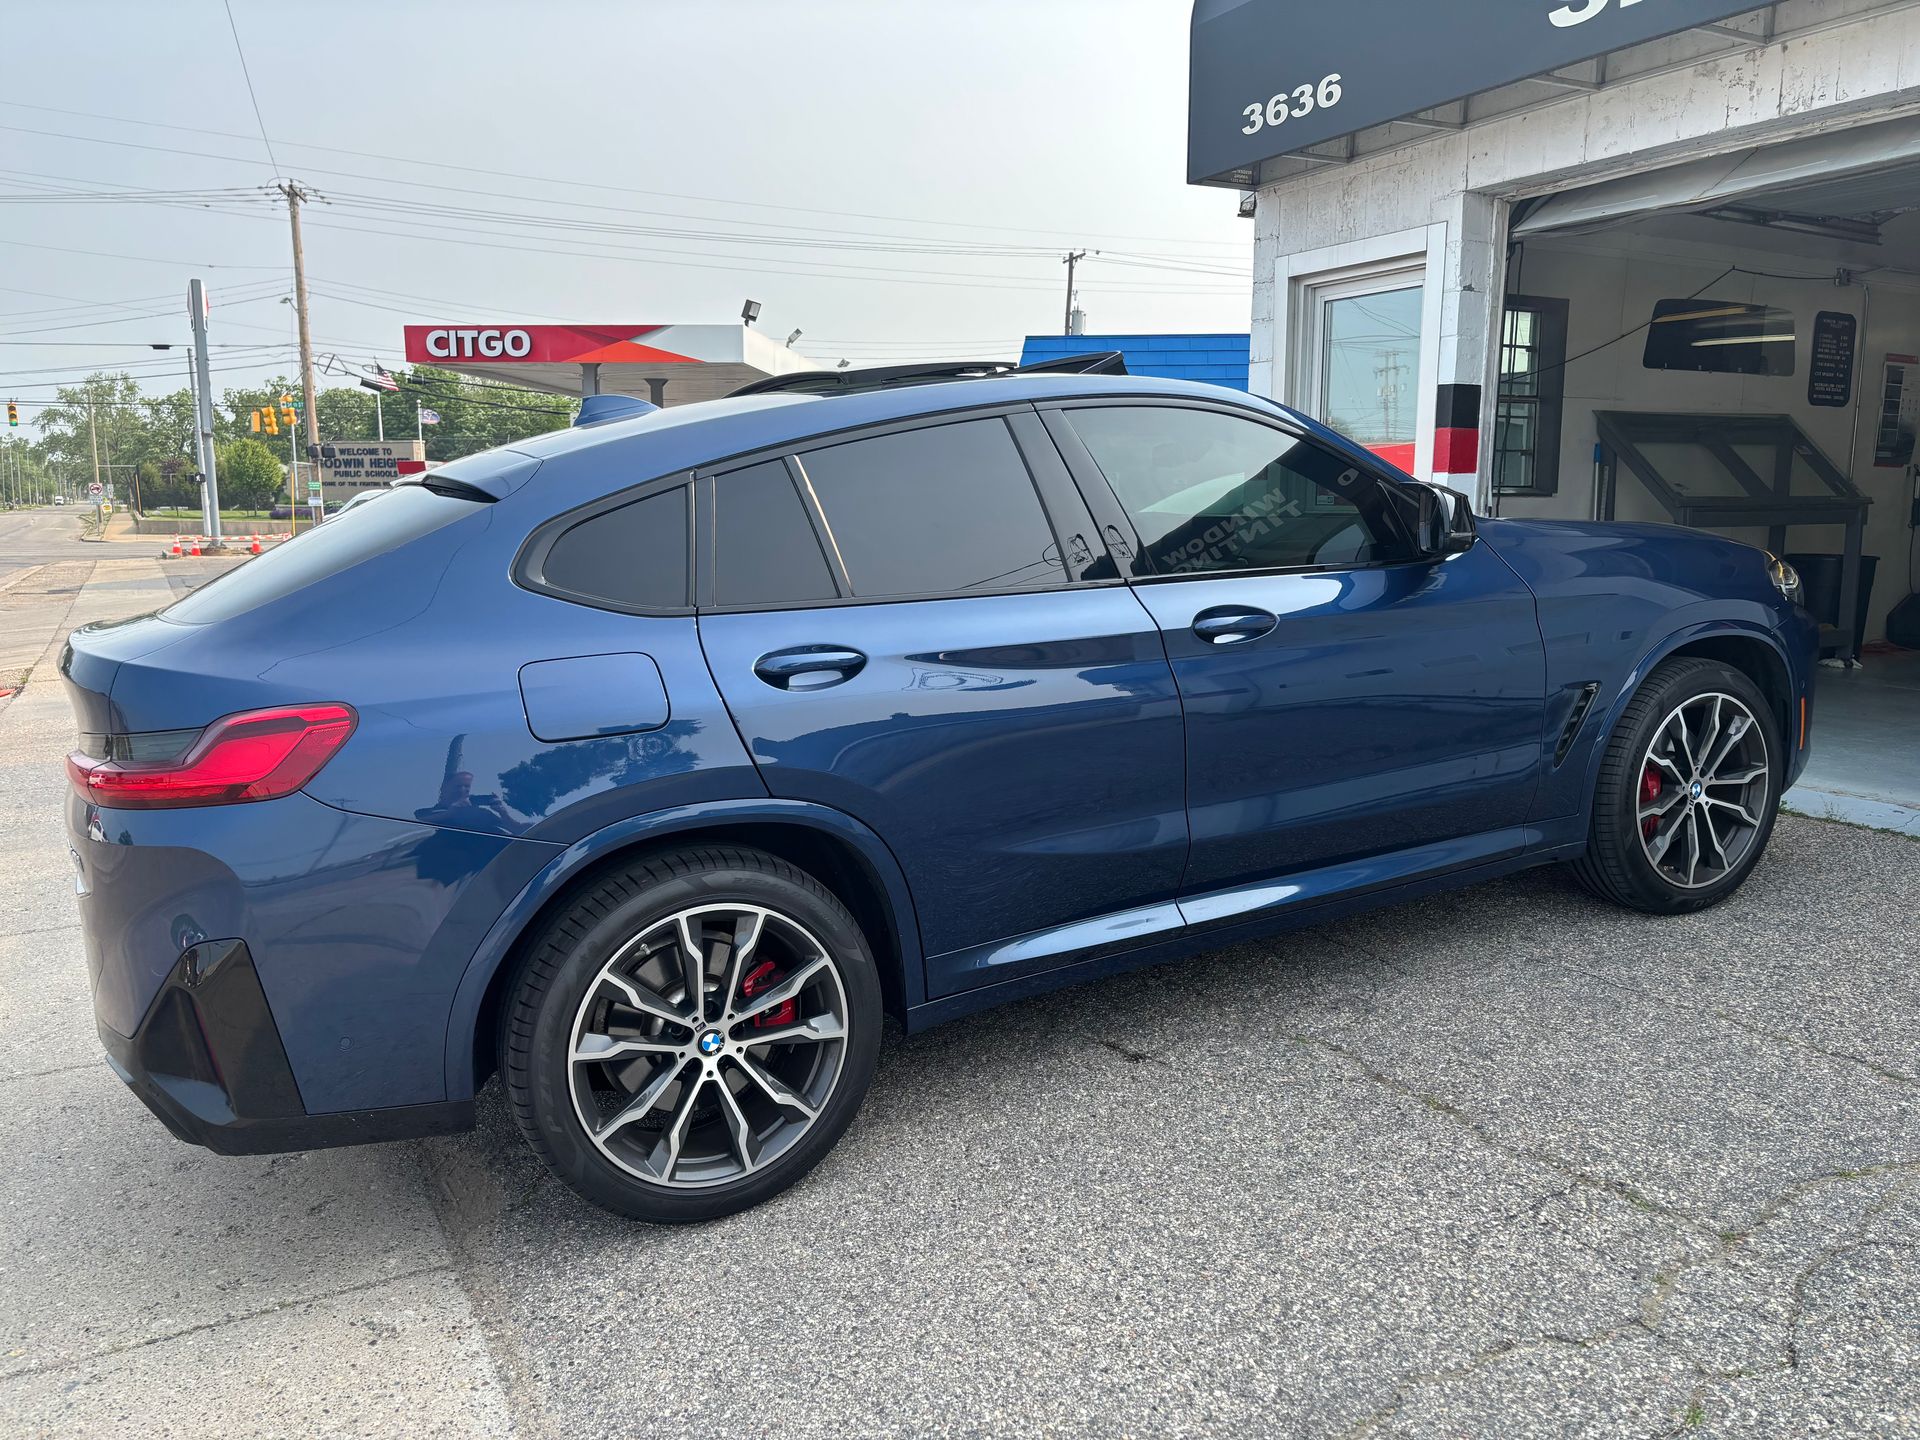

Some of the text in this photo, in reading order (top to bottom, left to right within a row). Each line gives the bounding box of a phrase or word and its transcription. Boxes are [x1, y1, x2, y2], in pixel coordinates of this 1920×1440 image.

[1241, 73, 1342, 135] 3636
[426, 329, 531, 358] CITGO
[338, 448, 392, 456] WELCOME TO
[369, 458, 411, 469] HEIGH
[334, 470, 398, 478] PUBLIC SCHOOLS
